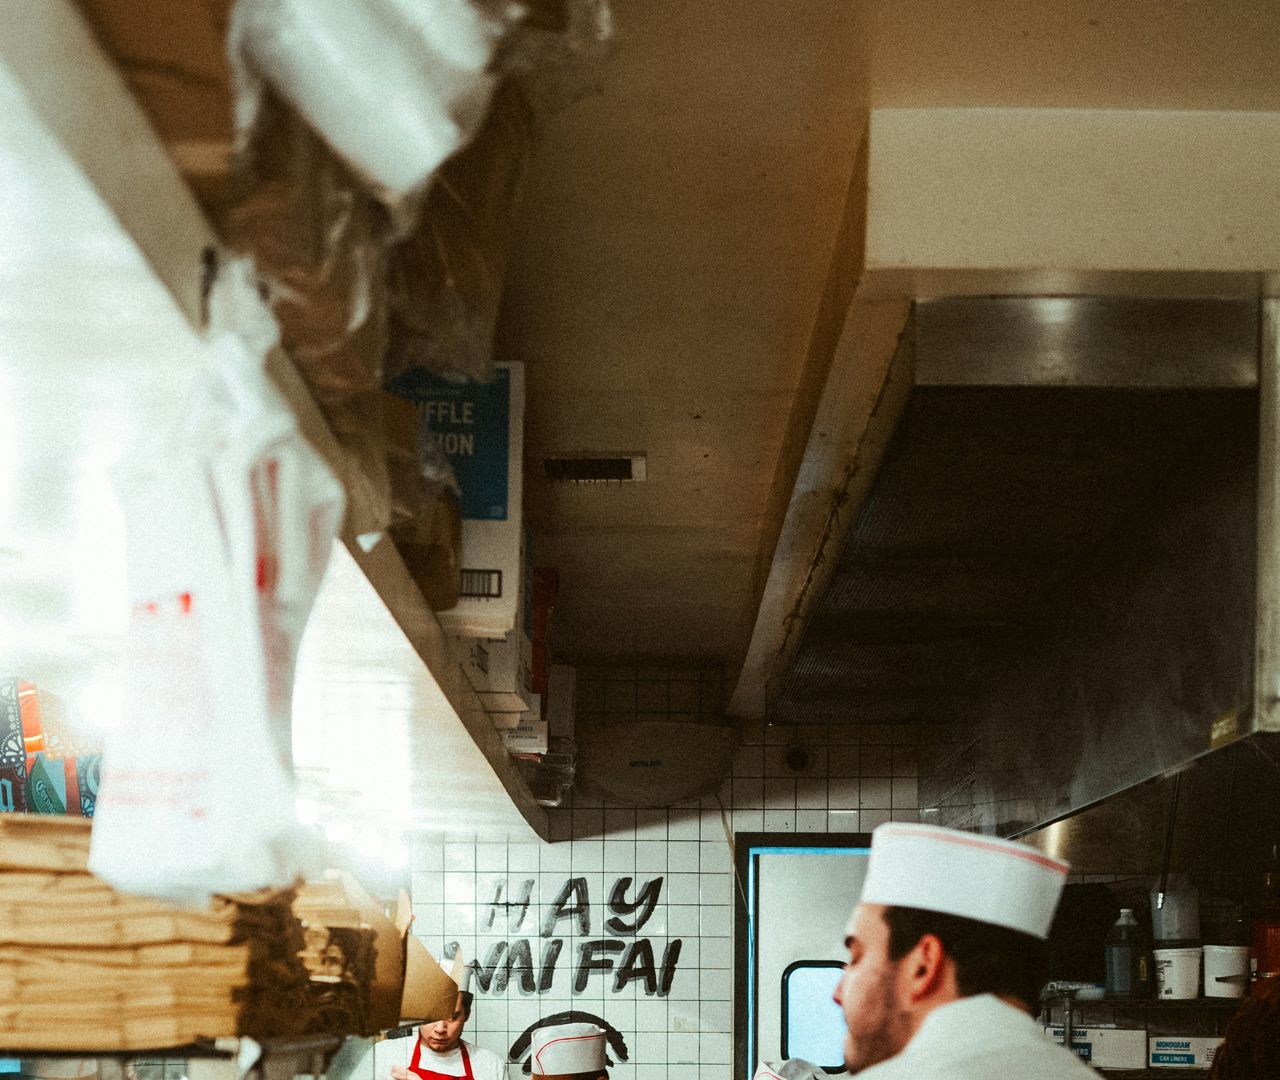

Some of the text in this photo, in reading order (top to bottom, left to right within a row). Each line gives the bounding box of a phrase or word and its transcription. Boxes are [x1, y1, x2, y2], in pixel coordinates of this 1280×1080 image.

[480, 876, 664, 938] HAY
[572, 938, 682, 997] FAI
[1155, 1040, 1191, 1050] MONOGRAM
